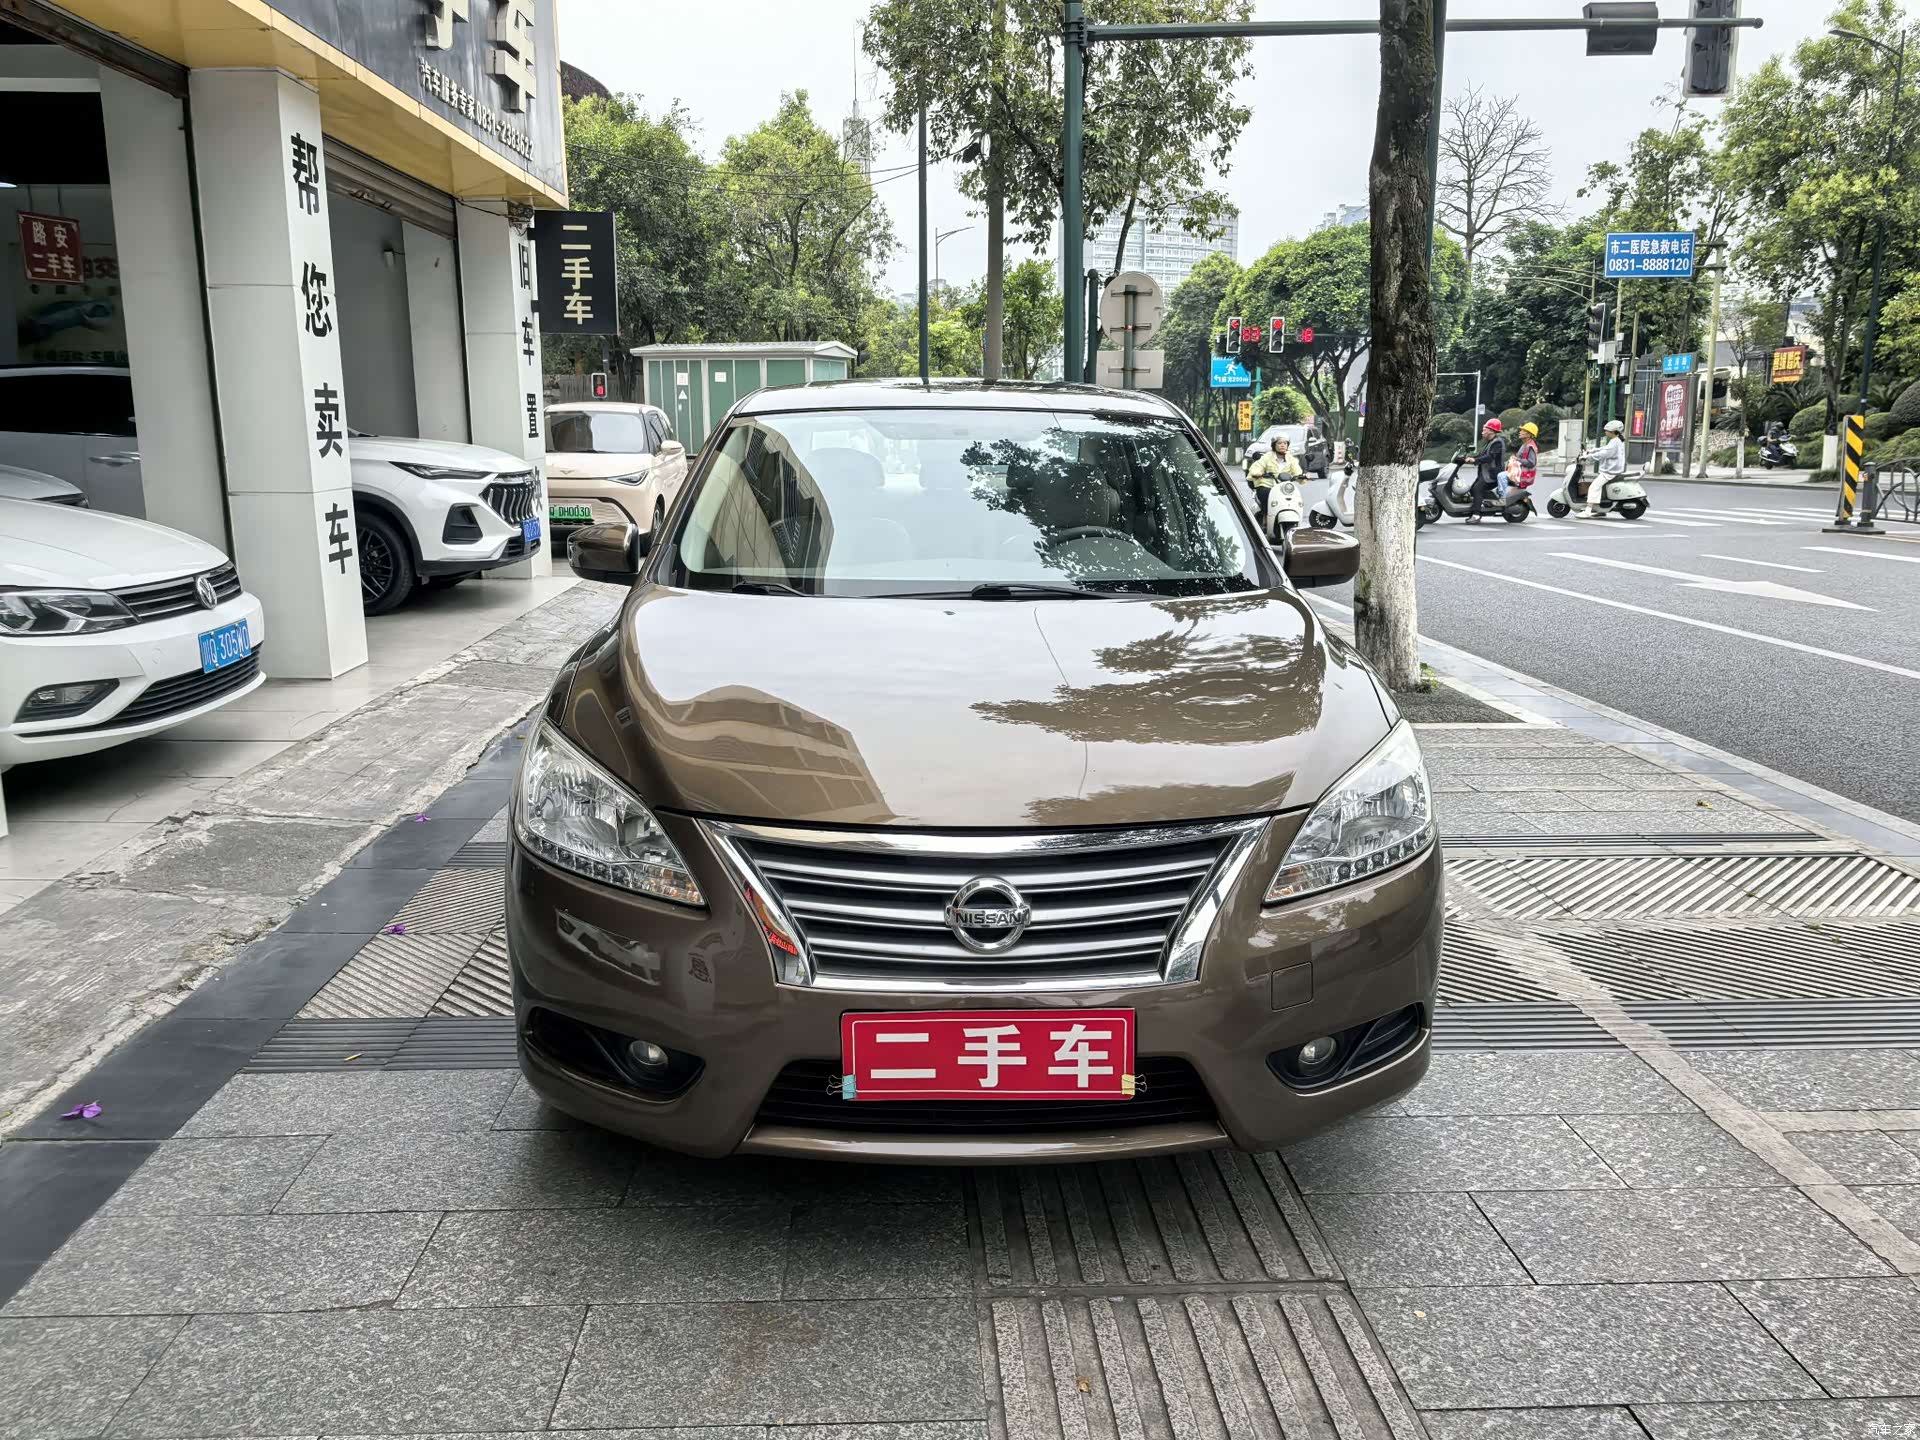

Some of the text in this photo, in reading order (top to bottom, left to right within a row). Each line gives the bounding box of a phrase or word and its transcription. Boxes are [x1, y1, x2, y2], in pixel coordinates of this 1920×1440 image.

[419, 57, 475, 121] 汽车服务专家
[32, 253, 77, 278] 二手车
[1609, 258, 1690, 271] 0831-8888120
[1610, 239, 1690, 255] 市二医院急救电话
[560, 225, 594, 325] 二手车
[291, 132, 353, 575] 帮您卖车
[955, 912, 1022, 925] NISSAN
[870, 1024, 1114, 1088] 二手车
